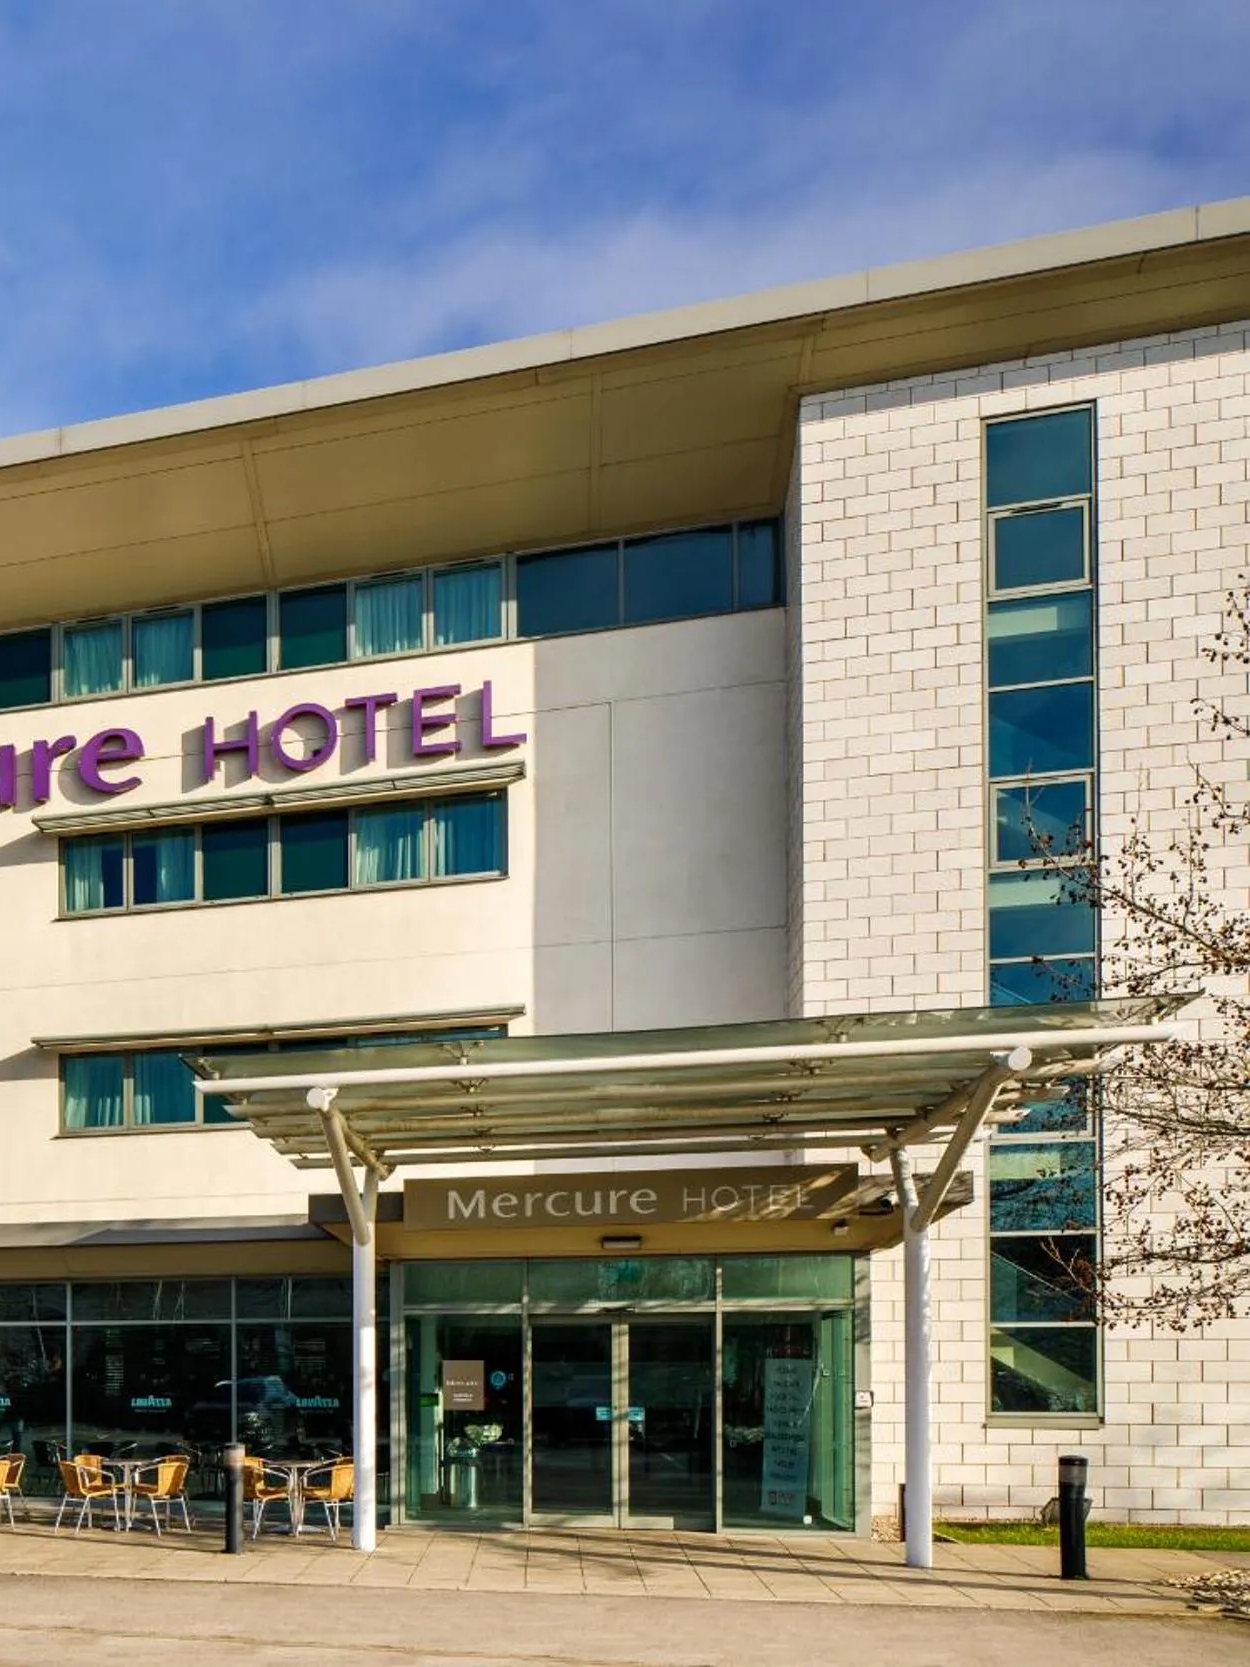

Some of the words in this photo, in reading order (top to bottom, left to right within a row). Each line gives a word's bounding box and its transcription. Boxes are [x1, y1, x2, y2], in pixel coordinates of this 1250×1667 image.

[203, 680, 527, 780] HOTEL
[447, 1188, 658, 1219] Mercure
[683, 1184, 815, 1214] HOTEL
